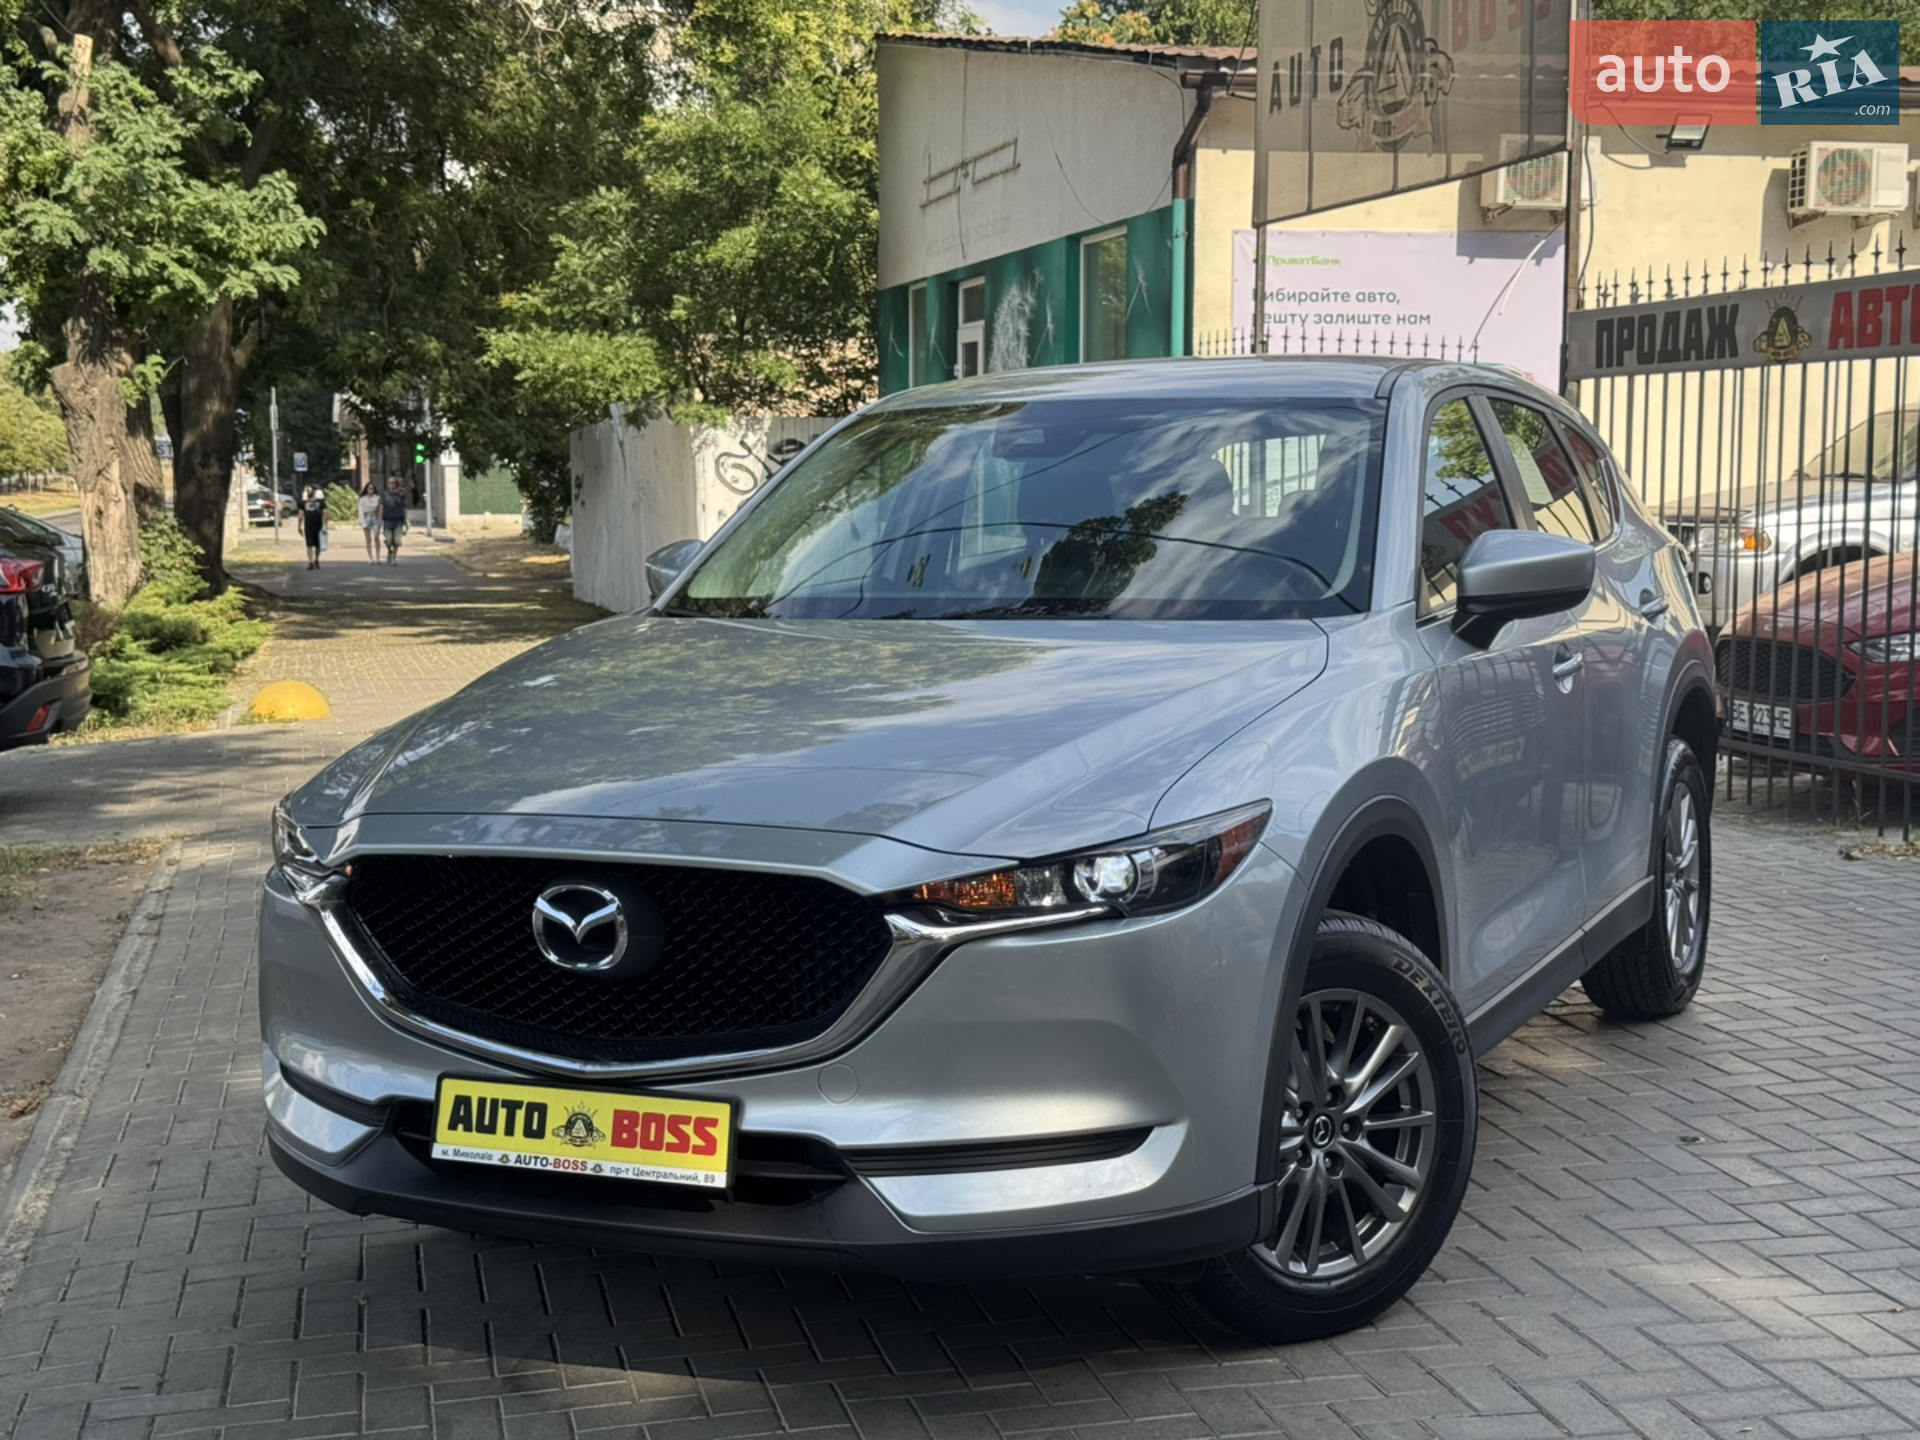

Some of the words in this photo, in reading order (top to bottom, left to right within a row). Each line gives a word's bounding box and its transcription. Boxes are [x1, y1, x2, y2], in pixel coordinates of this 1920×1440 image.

[1269, 36, 1343, 114] AUTO
[1266, 254, 1342, 267] ПриватБанк
[1355, 291, 1401, 305] авто,
[1313, 313, 1392, 326] залиште
[1396, 315, 1431, 326] нам
[1595, 303, 1739, 369] ПРОДАЖ
[1390, 948, 1466, 1055] DEXTERO
[447, 1094, 549, 1140] AUTO
[611, 1109, 719, 1156] BOSS
[632, 1166, 701, 1183] Центральний,
[703, 1173, 716, 1184] 89
